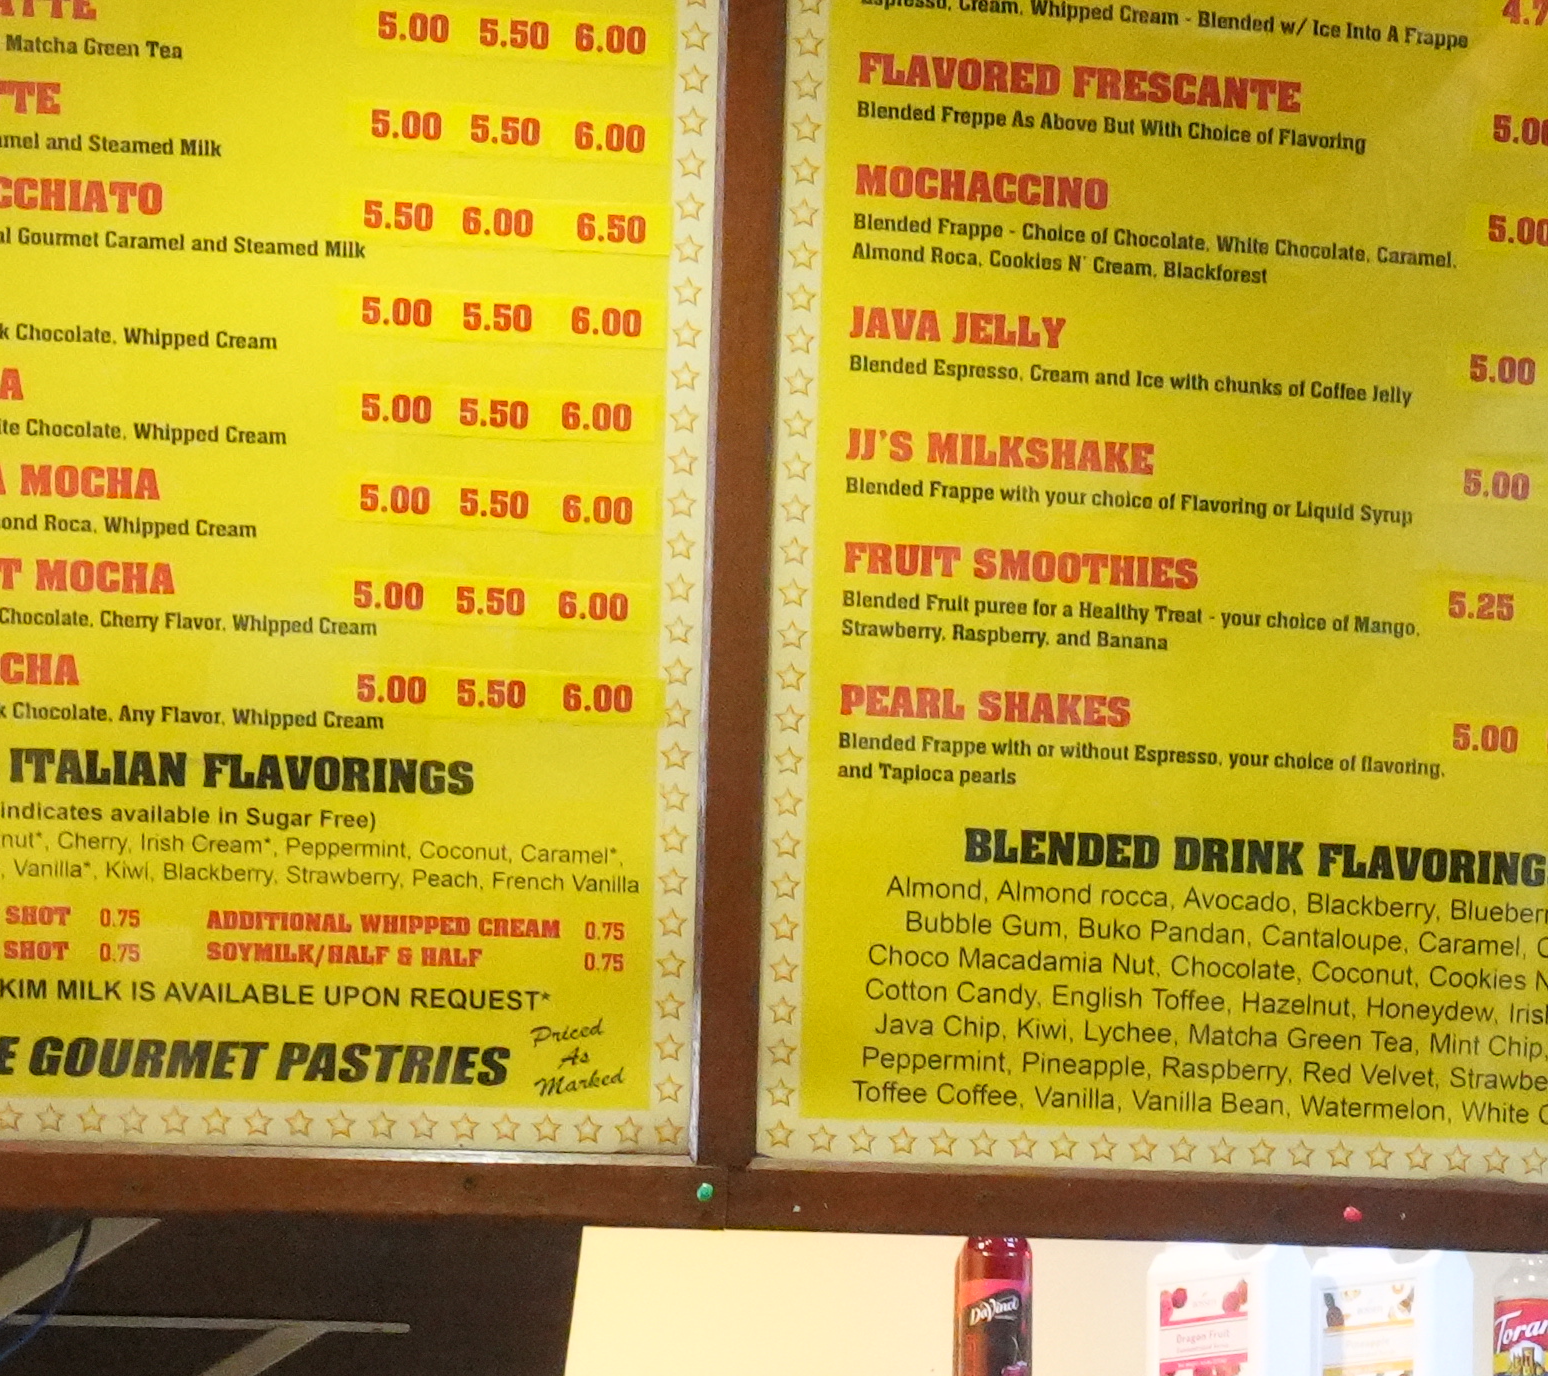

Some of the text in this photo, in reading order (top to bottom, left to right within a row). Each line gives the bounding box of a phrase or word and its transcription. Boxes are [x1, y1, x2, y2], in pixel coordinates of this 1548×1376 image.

[860, 52, 1301, 113] FLAVORED FRESCANTE
[46, 134, 82, 151] and
[89, 135, 173, 155] Steamed
[181, 139, 221, 157] Milk
[372, 109, 645, 153] 5.00 5.50 6.00
[857, 165, 1108, 210] MOCHACCINO
[10, 748, 187, 787] ITALIAN
[204, 753, 473, 795] FLAVORINGS
[965, 828, 1159, 869] BLENDED
[1174, 837, 1303, 875] DRINK
[530, 1018, 603, 1047] Priced
[29, 1036, 269, 1079] GOURMET
[276, 1042, 510, 1086] PASTRIES
[561, 1047, 589, 1066] As
[534, 1067, 623, 1096] Marked
[852, 1080, 927, 1103] Toffee
[936, 1082, 1025, 1112] Coffee,
[1033, 1086, 1120, 1114] Vanilla,
[1132, 1090, 1211, 1112] Vanilla
[1220, 1091, 1292, 1122] Bean,
[1300, 1094, 1453, 1125] Watermelon,
[1462, 1102, 1529, 1124] White
